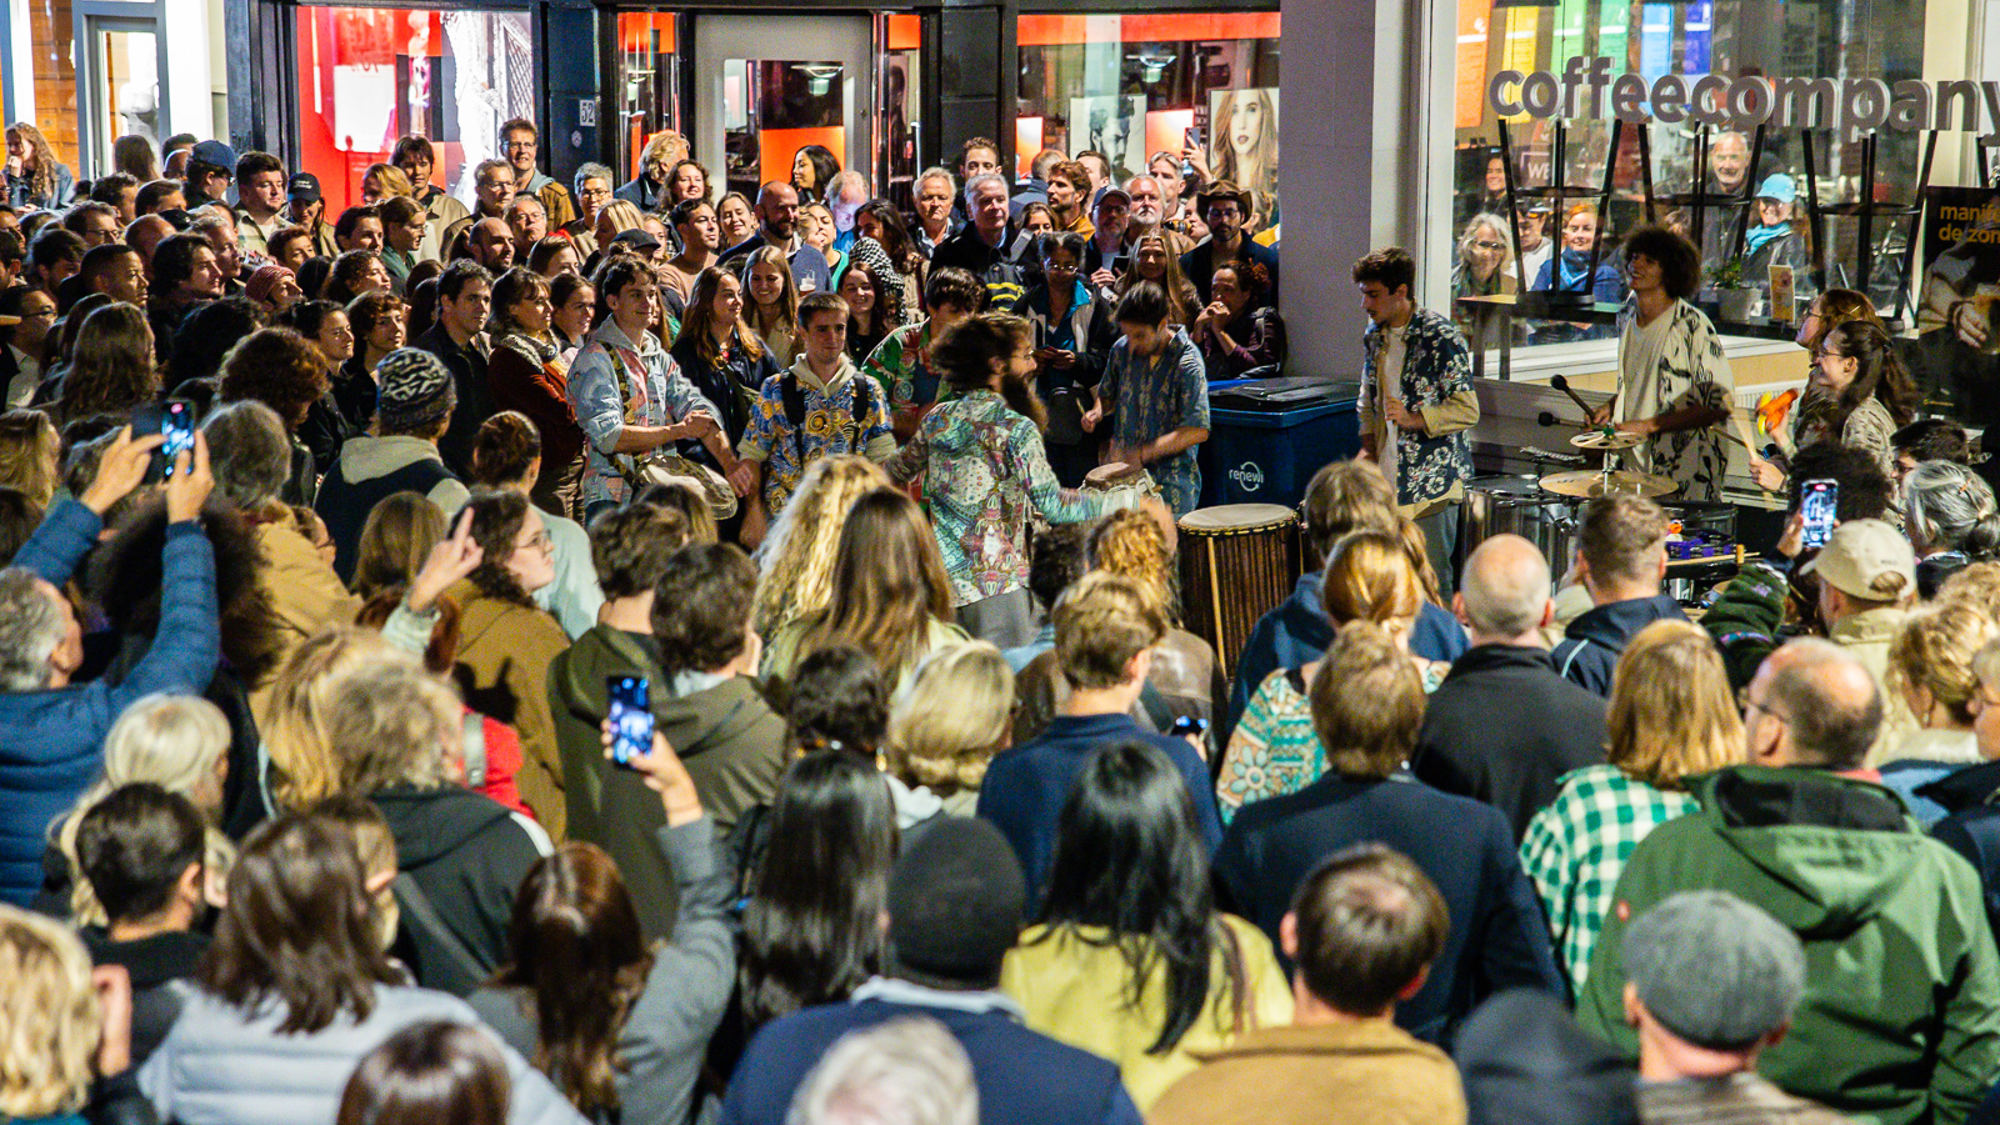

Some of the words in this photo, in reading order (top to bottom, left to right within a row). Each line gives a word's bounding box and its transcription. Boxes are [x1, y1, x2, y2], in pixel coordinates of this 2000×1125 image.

[581, 101, 594, 122] 52
[1938, 222, 1962, 242] de
[1229, 469, 1264, 484] renewi
